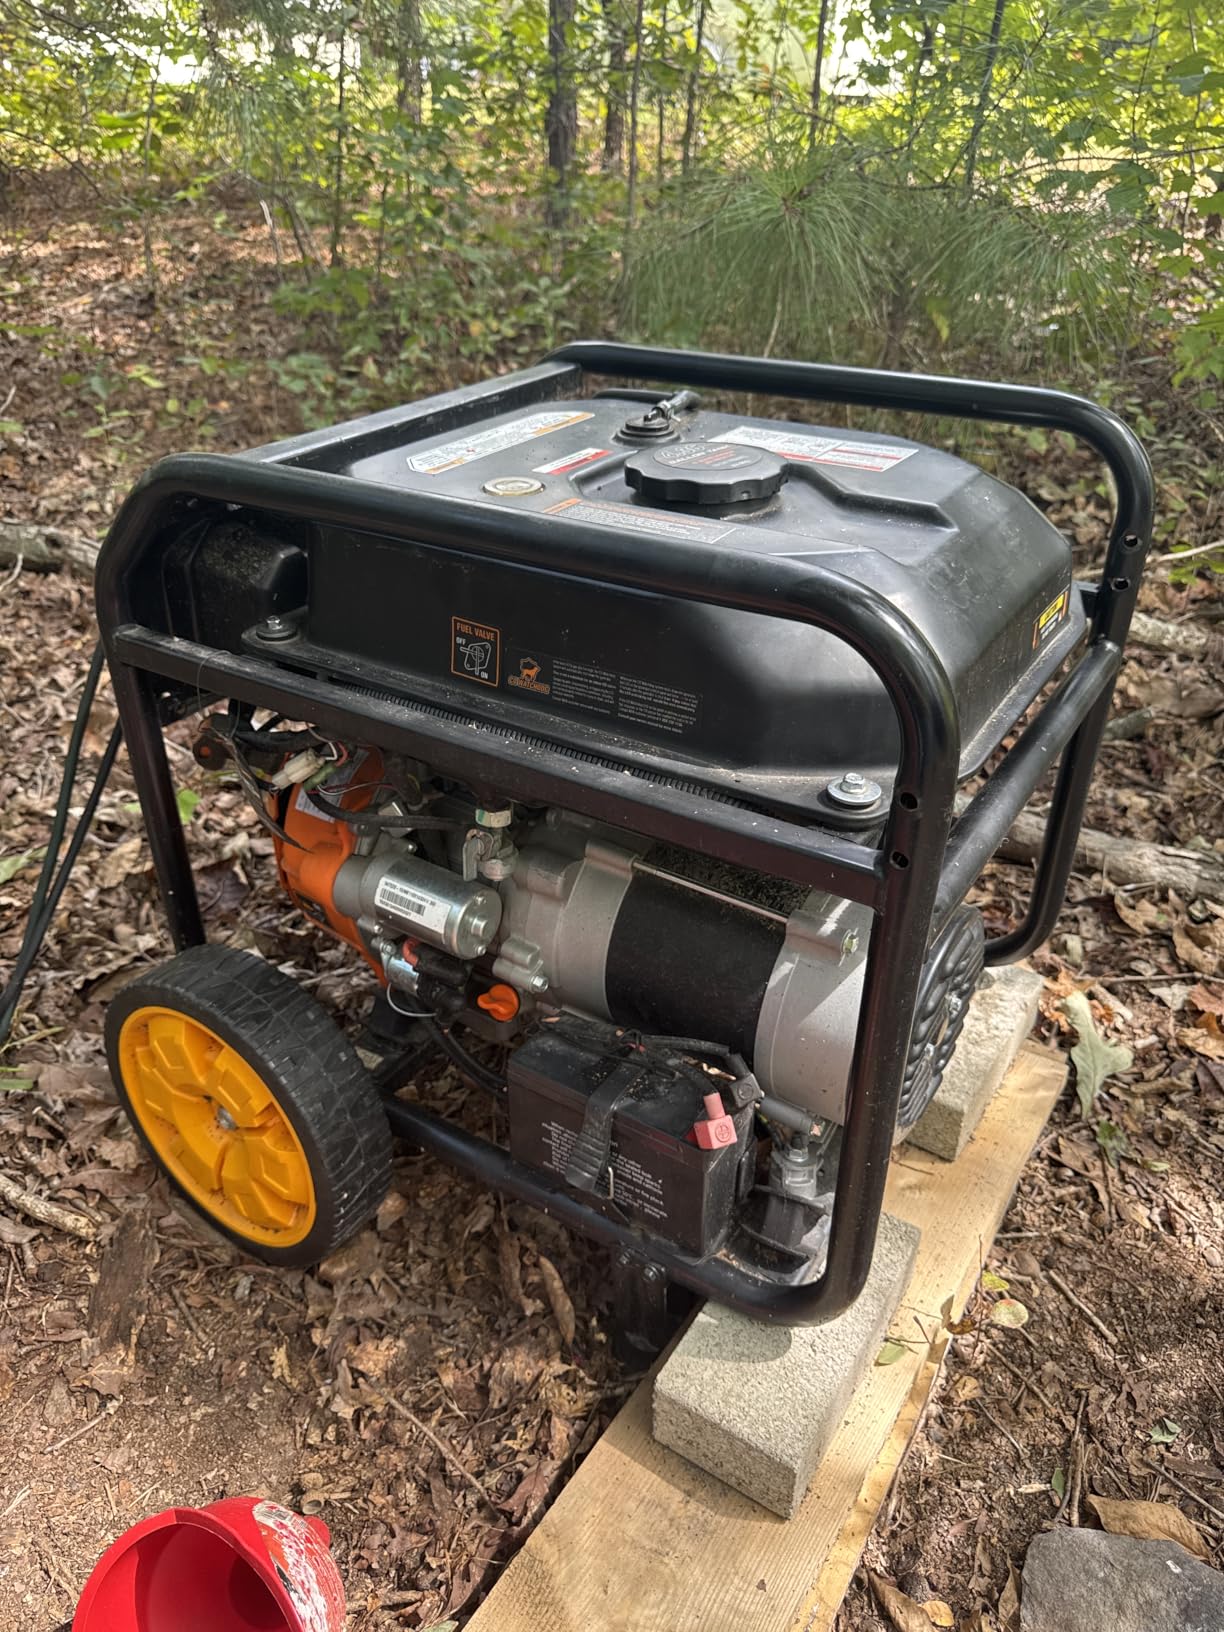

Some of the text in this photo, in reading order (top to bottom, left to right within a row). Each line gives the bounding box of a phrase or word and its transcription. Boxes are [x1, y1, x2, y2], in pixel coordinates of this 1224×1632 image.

[456, 622, 495, 641] FUEL VALVE
[456, 636, 466, 645] OFF
[480, 671, 488, 679] ON
